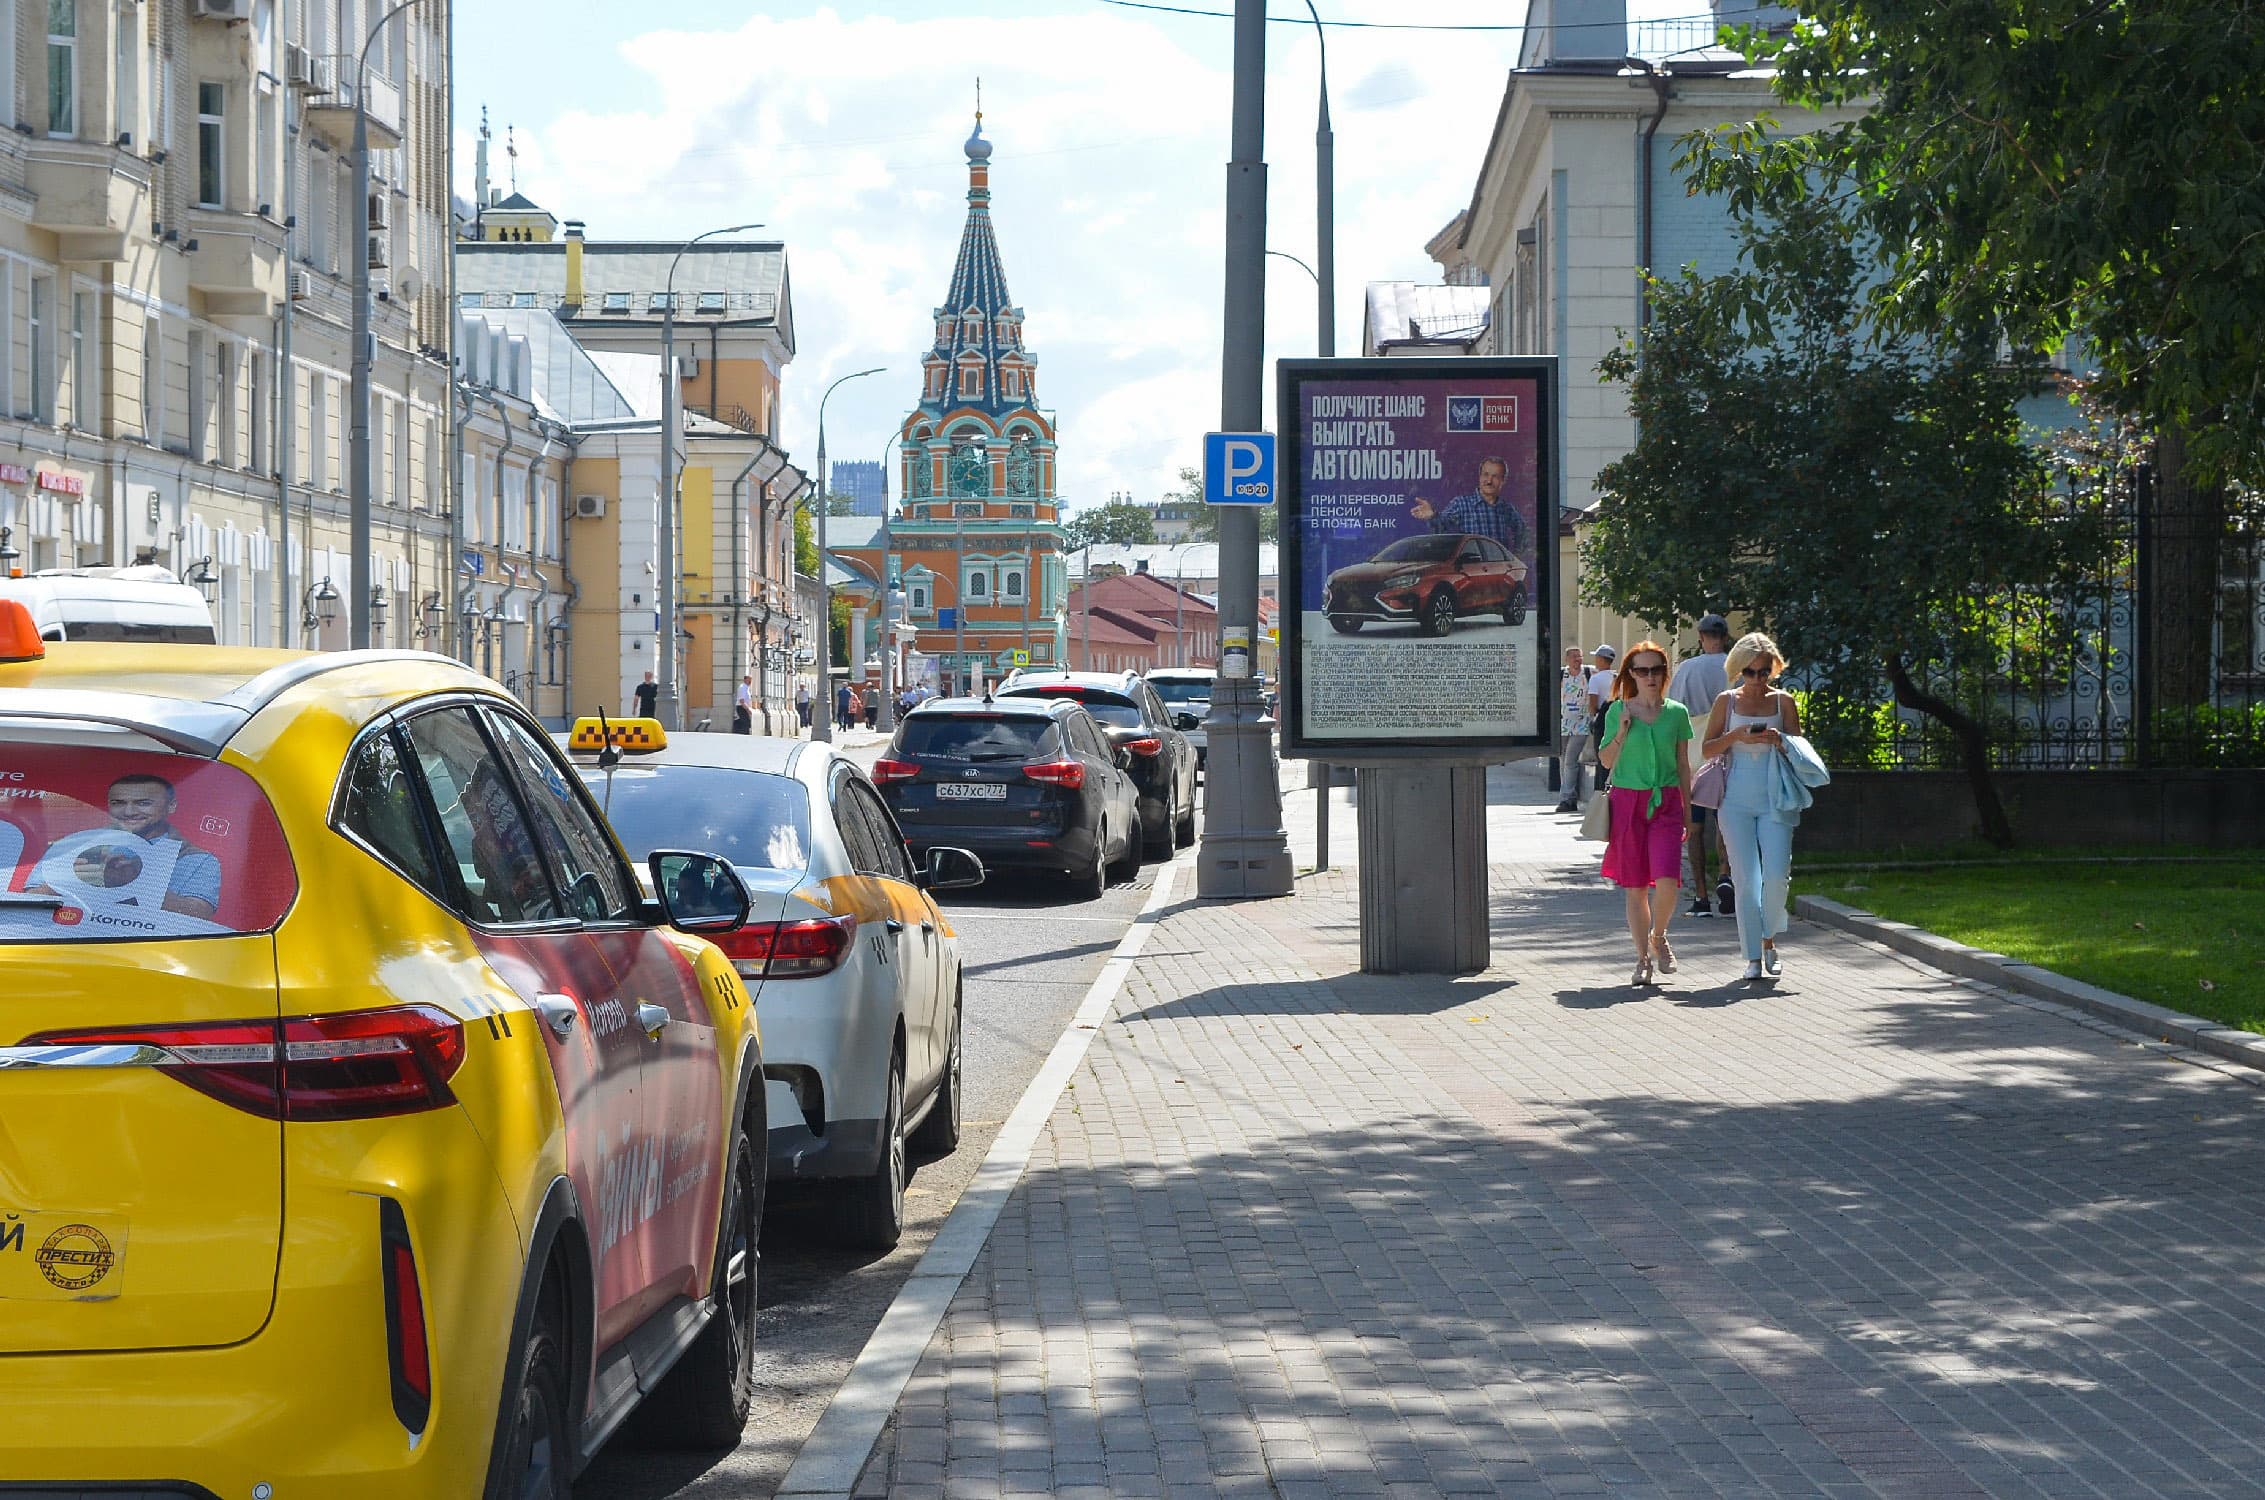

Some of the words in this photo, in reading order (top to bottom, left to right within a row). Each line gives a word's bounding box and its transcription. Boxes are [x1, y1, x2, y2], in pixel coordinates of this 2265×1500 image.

[1311, 395, 1383, 418] ПОЛУЧИТЕ
[1384, 395, 1426, 418] ШАНС
[1485, 404, 1513, 415] ПОЧТА
[1485, 414, 1510, 424] БАНК
[1311, 420, 1395, 447] ВЫИГРАТЬ
[1224, 441, 1263, 497] P
[1311, 449, 1443, 481] АВТОМОБИЛЬ
[1246, 485, 1254, 494] 15
[1256, 485, 1268, 494] 20
[1311, 494, 1337, 505] ПРИ
[1339, 494, 1405, 505] ПЕРЕВОДЕ
[1311, 506, 1362, 517] ПЕНСИИ
[1311, 518, 1319, 529] В
[1322, 518, 1362, 529] ПОЧТА
[1364, 518, 1397, 529] БАНК
[985, 784, 1003, 795] 777
[90, 912, 156, 931] Korona
[39, 1250, 111, 1265] ПРЕСТИЖ
[57, 1279, 88, 1288] АВТО
